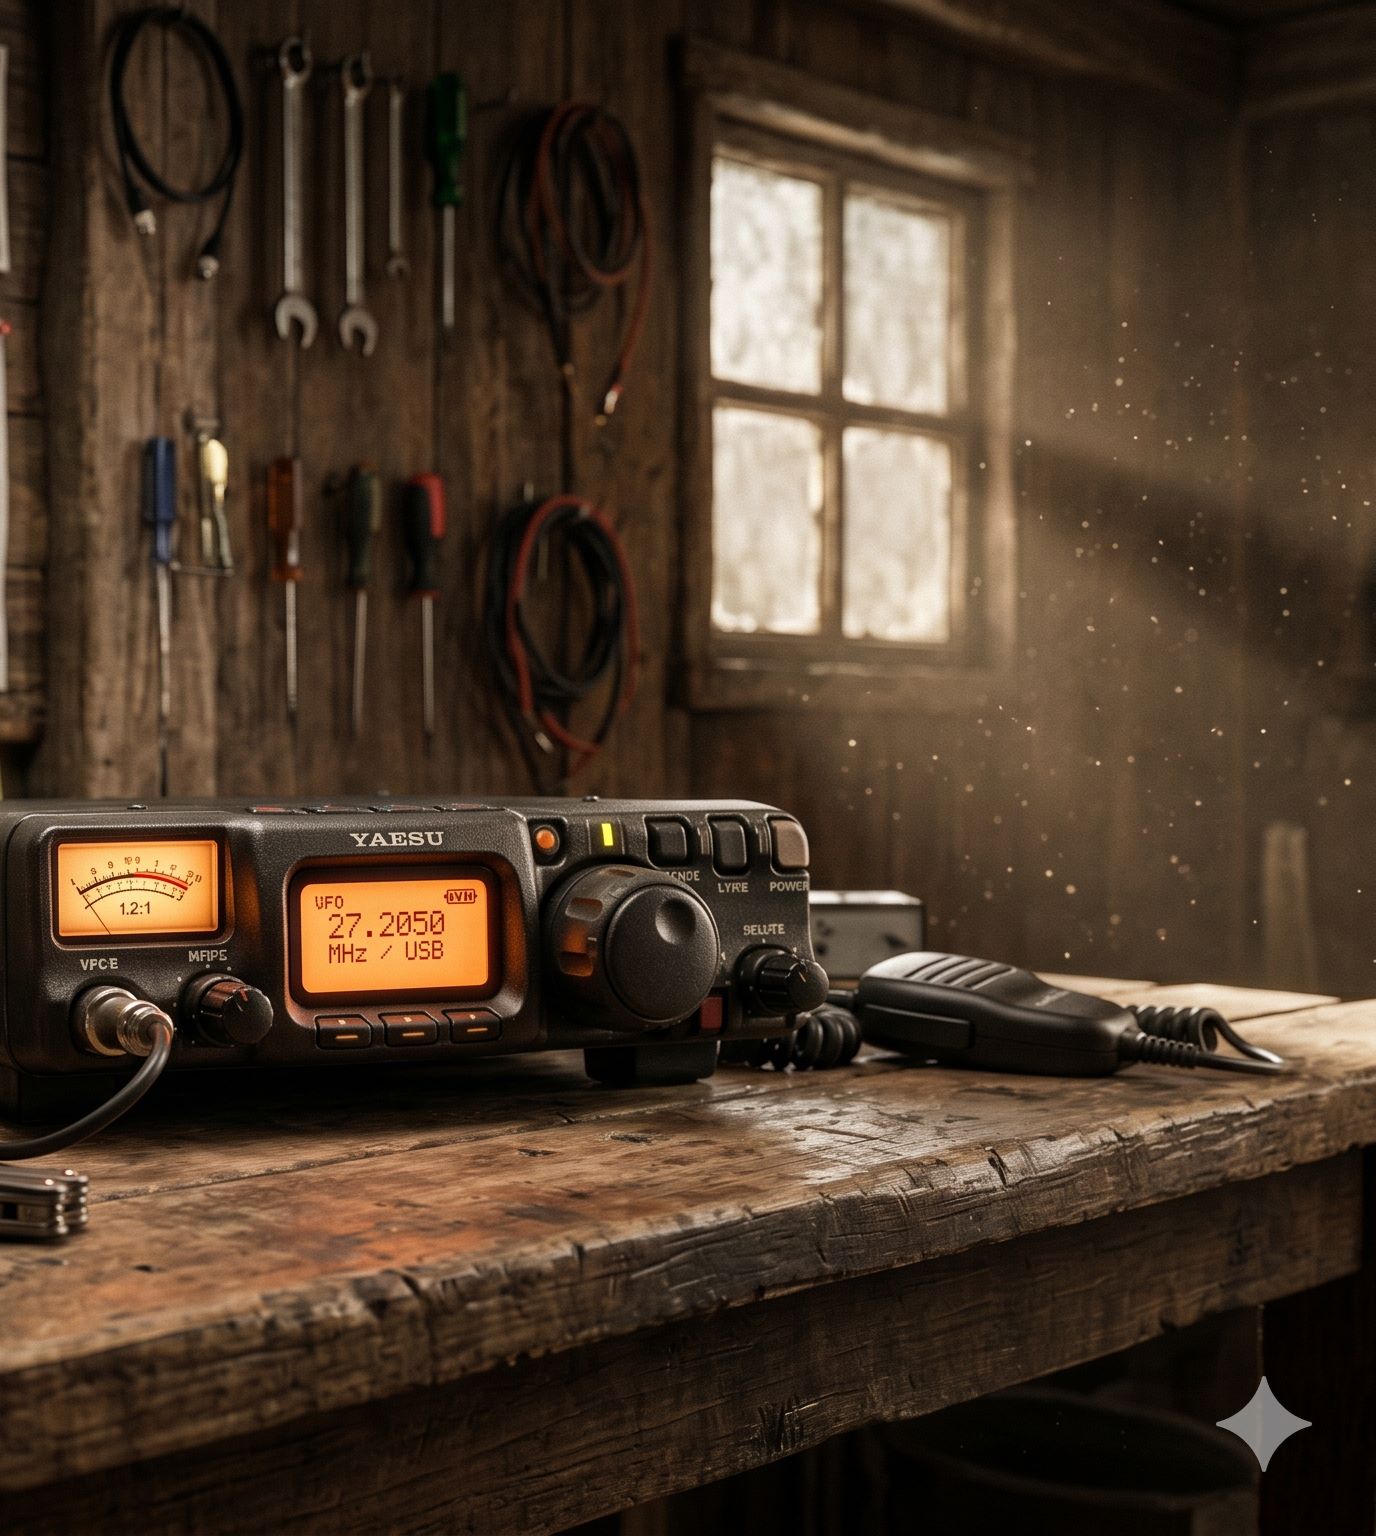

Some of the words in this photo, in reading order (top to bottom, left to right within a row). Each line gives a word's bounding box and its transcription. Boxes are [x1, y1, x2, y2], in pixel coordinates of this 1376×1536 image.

[349, 831, 444, 847] YAESU
[769, 881, 809, 892] POWER
[119, 901, 151, 915] 1.2:1
[328, 910, 445, 939] 27.2050
[328, 943, 367, 964] MHz
[380, 944, 393, 960] /
[405, 940, 444, 960] USB
